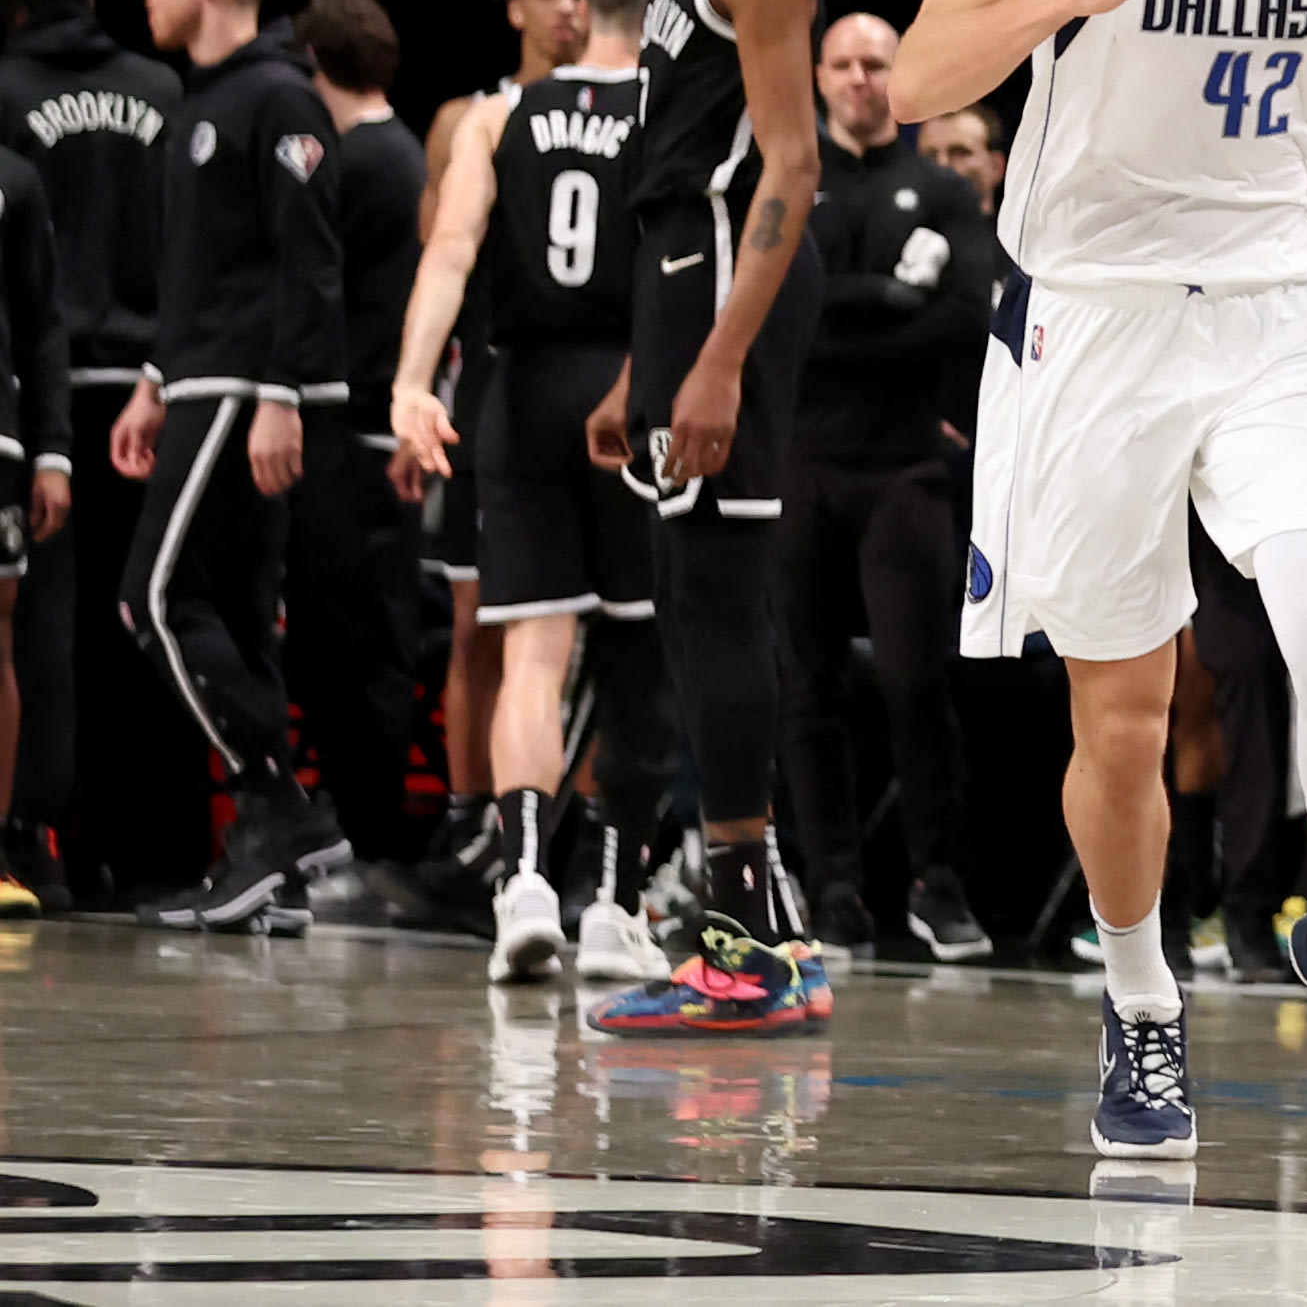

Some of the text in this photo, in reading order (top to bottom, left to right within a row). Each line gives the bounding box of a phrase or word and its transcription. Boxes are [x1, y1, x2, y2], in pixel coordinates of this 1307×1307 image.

[27, 91, 164, 148] BROOKLYN
[1202, 50, 1304, 138] 42
[547, 169, 600, 288] 9
